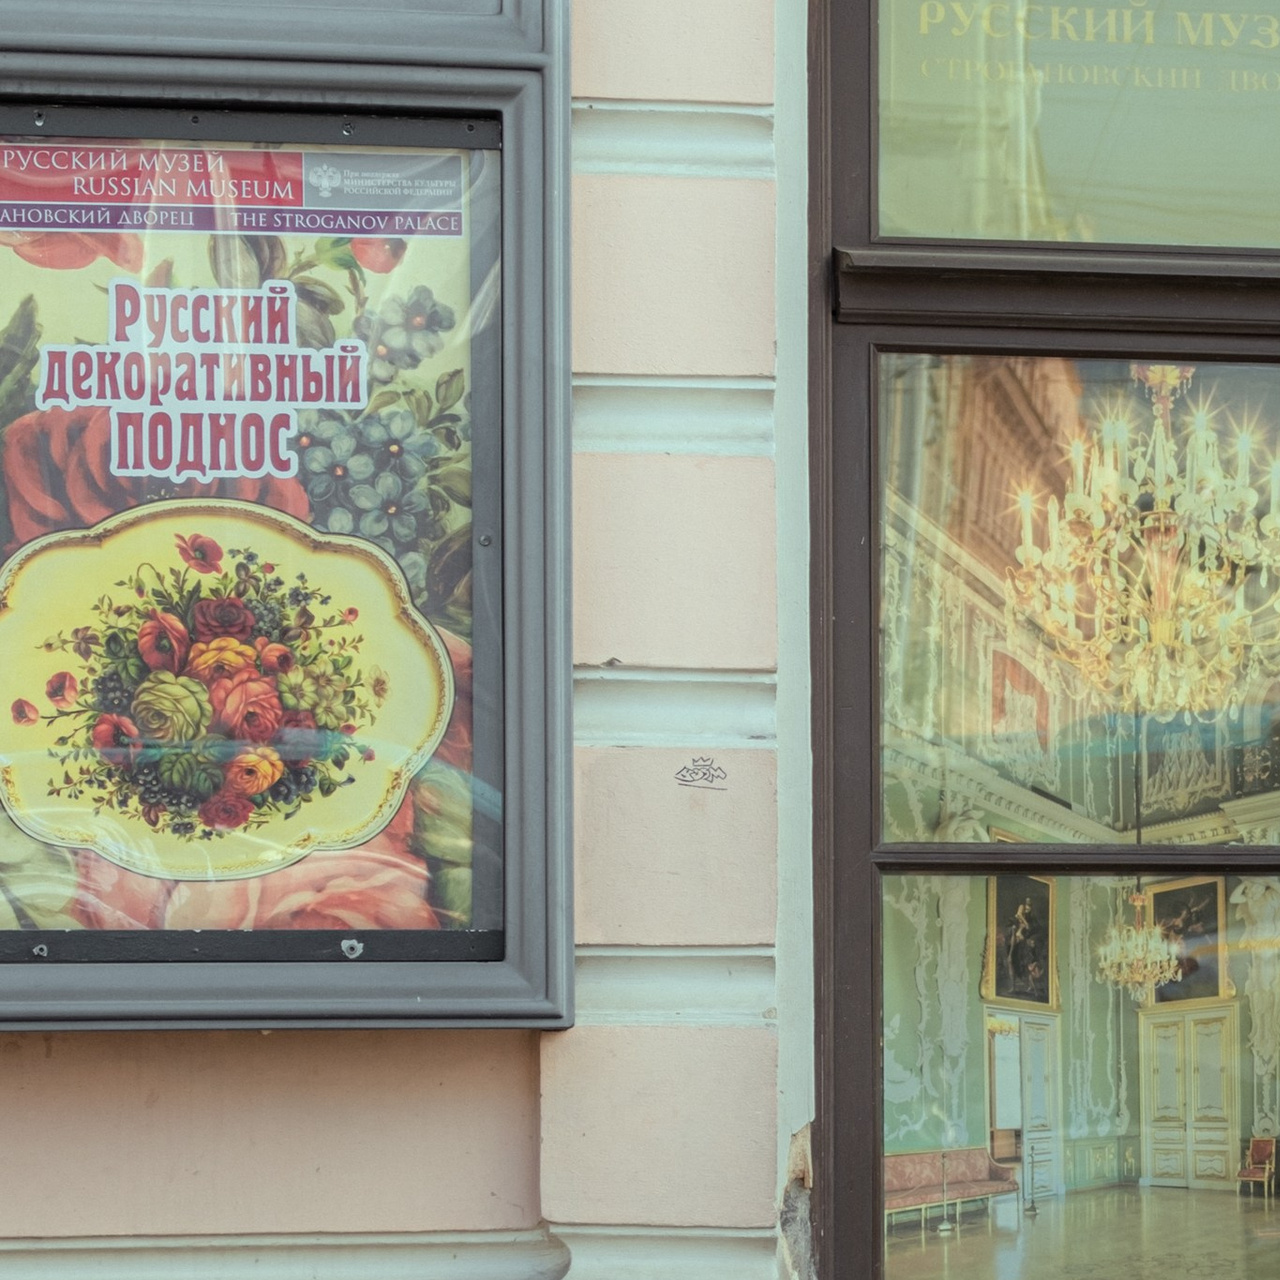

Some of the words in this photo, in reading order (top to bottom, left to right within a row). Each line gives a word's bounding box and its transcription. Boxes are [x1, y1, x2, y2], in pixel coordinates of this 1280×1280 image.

[3, 149, 129, 171] РУССКИЙ
[138, 151, 224, 173] МУЗЕЙ
[73, 177, 176, 197] RUSSIAN
[187, 179, 294, 200] MUSEUM
[117, 209, 195, 226] ДВОРЕЦ
[230, 211, 267, 227] THE
[273, 213, 389, 230] STROGANOV
[394, 216, 459, 231] PALACE
[114, 284, 291, 348] Русский
[41, 345, 361, 407] декоративный
